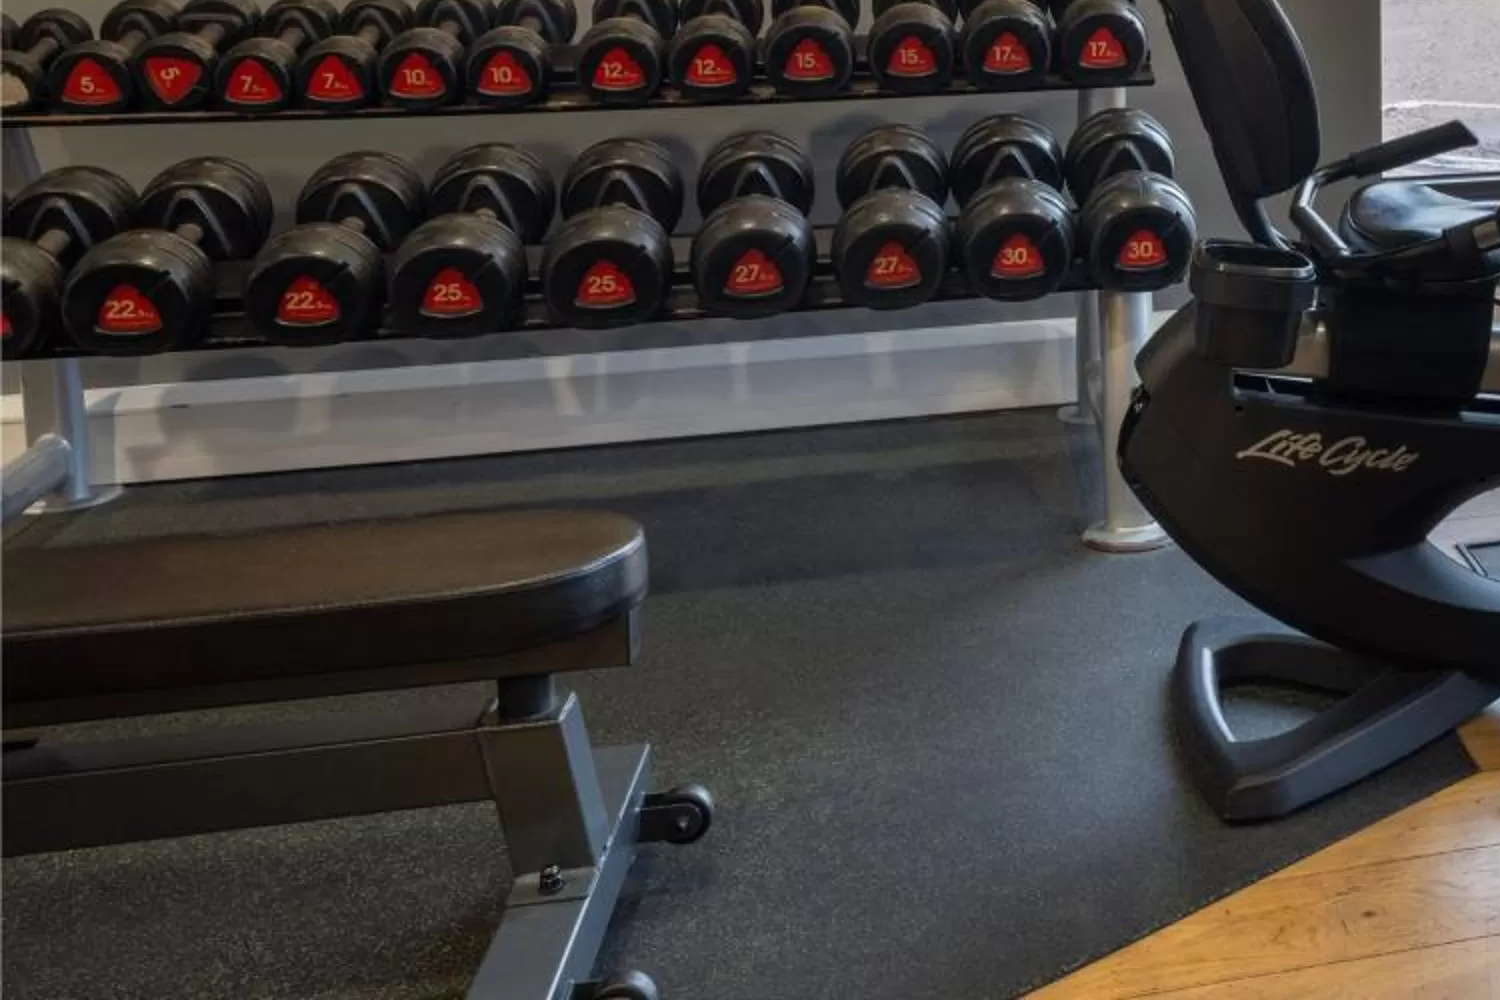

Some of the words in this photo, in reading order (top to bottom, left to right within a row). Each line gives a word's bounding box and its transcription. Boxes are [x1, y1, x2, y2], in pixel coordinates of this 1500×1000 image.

[80, 76, 95, 93] 5
[1236, 429, 1323, 467] Life
[1319, 436, 1419, 475] Cycle
